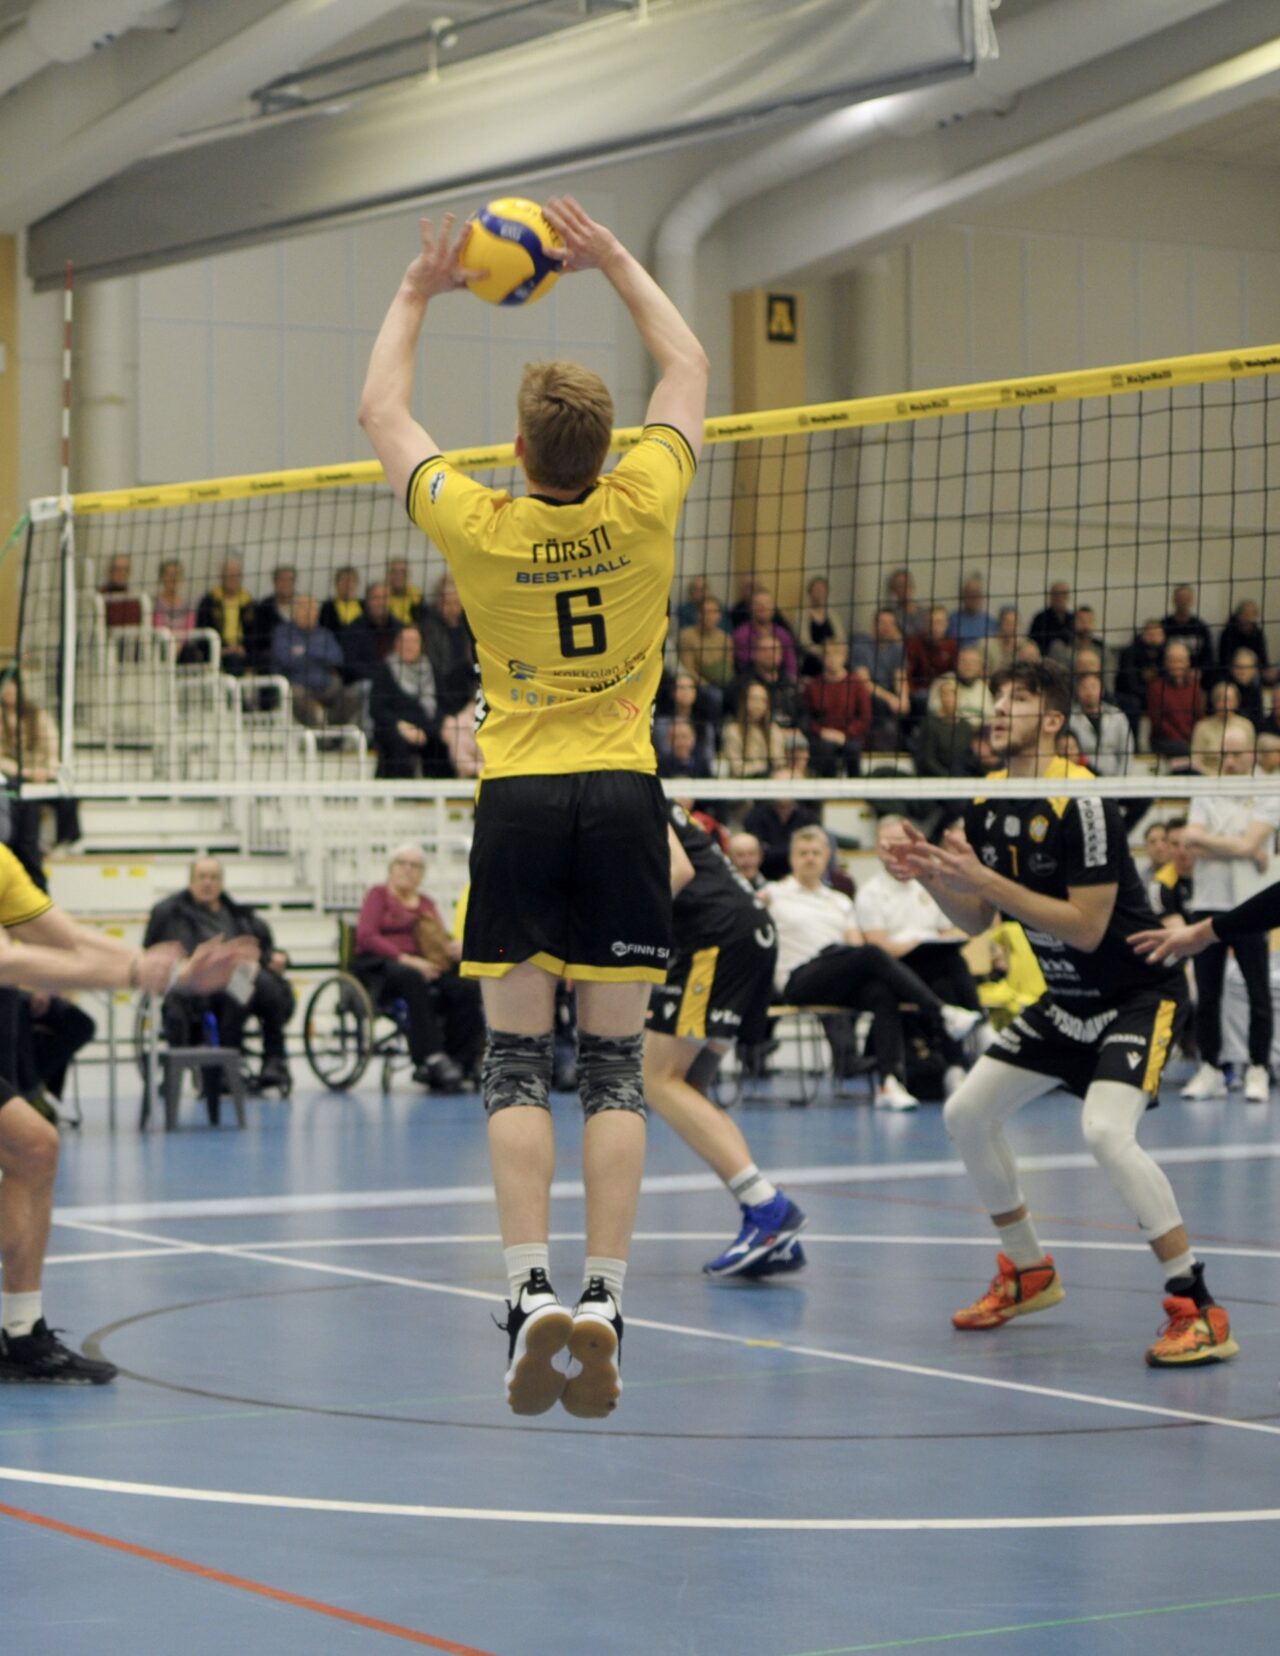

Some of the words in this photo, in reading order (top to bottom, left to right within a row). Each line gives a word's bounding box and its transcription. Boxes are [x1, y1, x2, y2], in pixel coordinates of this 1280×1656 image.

[771, 301, 793, 334] A
[532, 524, 612, 564] FÖRSTI
[516, 554, 632, 584] BEST-HALL
[555, 586, 607, 658] 6
[626, 943, 655, 956] FINN
